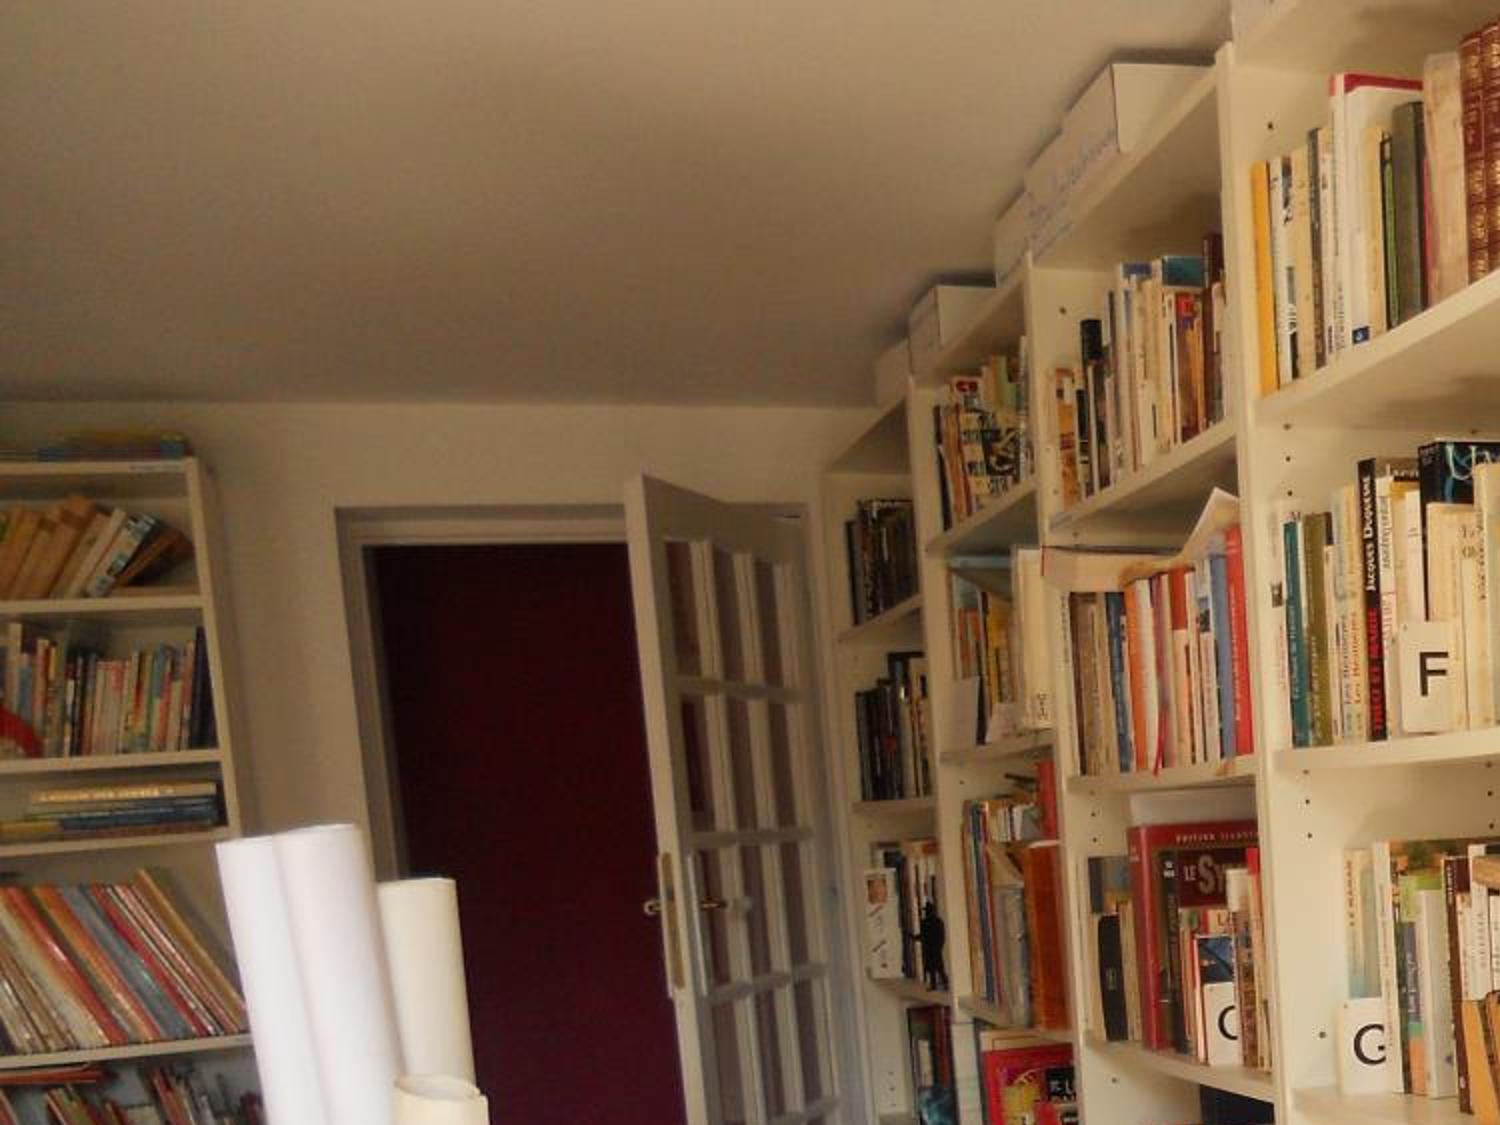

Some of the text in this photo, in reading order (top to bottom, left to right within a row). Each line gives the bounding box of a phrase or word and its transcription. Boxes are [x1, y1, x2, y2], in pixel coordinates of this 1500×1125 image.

[1364, 535, 1378, 592] JACQUES
[1418, 651, 1450, 697] F
[1352, 1022, 1387, 1066] G
